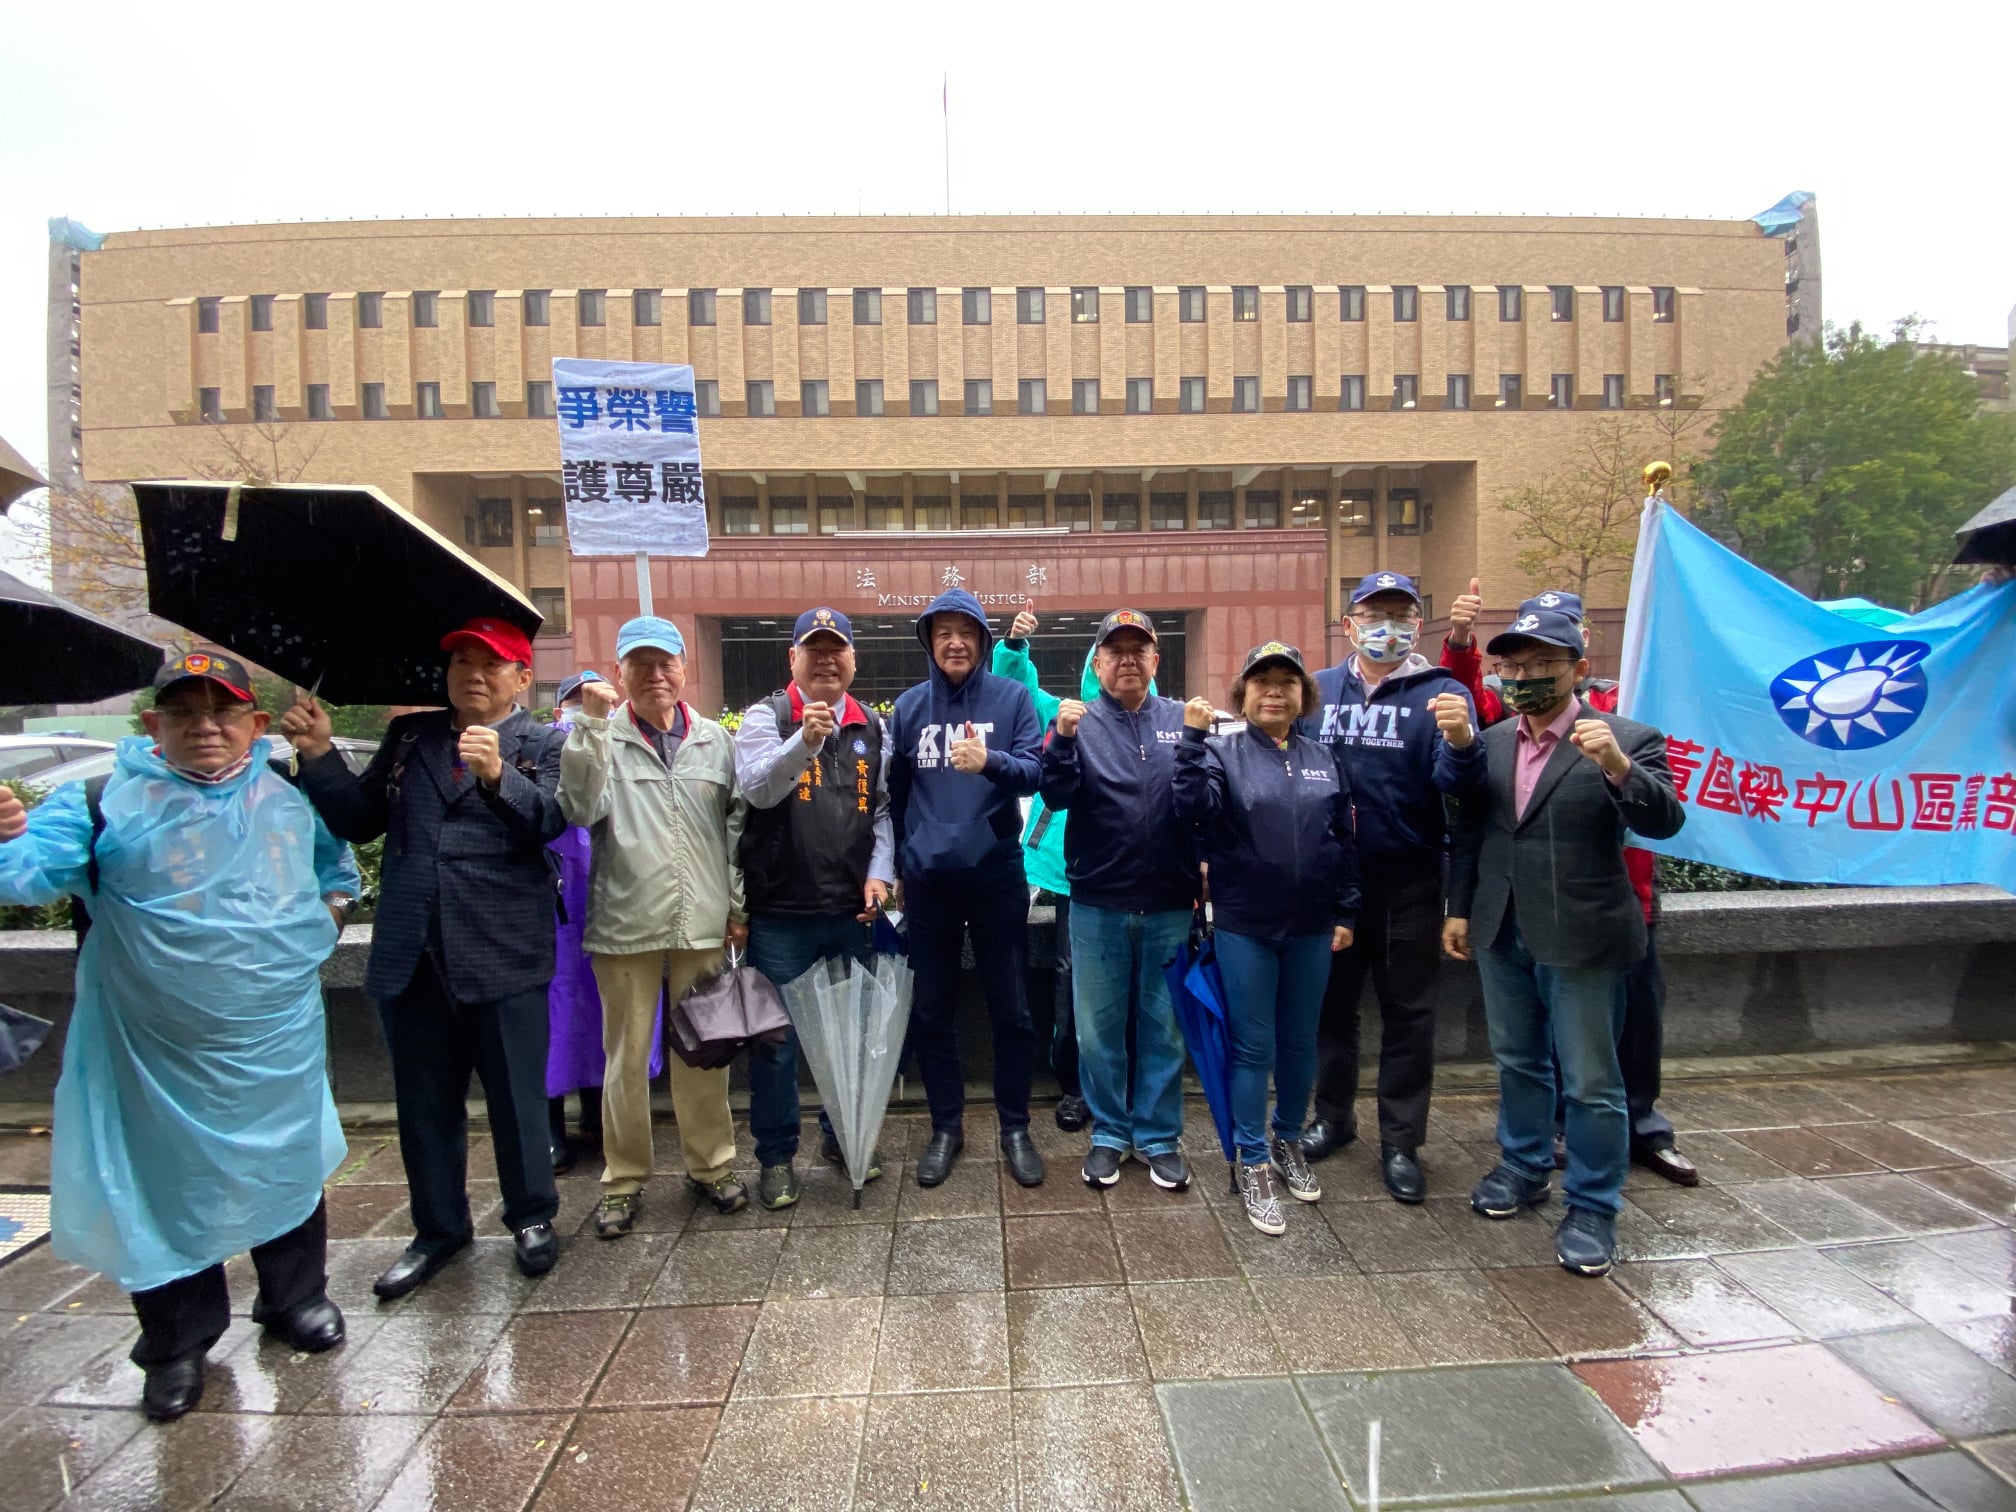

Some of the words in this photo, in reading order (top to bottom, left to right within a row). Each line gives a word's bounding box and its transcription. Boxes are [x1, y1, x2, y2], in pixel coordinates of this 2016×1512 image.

[557, 387, 697, 434] 爭榮譽
[562, 460, 704, 504] 護尊嚴
[856, 564, 1047, 588] 法務部
[878, 593, 937, 607] MINISTR
[1156, 730, 1183, 740] KMT
[1320, 703, 1411, 739] KMT
[917, 722, 994, 759] KMT
[1344, 736, 1354, 746] IN
[1360, 737, 1404, 748] TOGETHER
[856, 759, 870, 814] 黃復興
[1301, 768, 1328, 778] KMT
